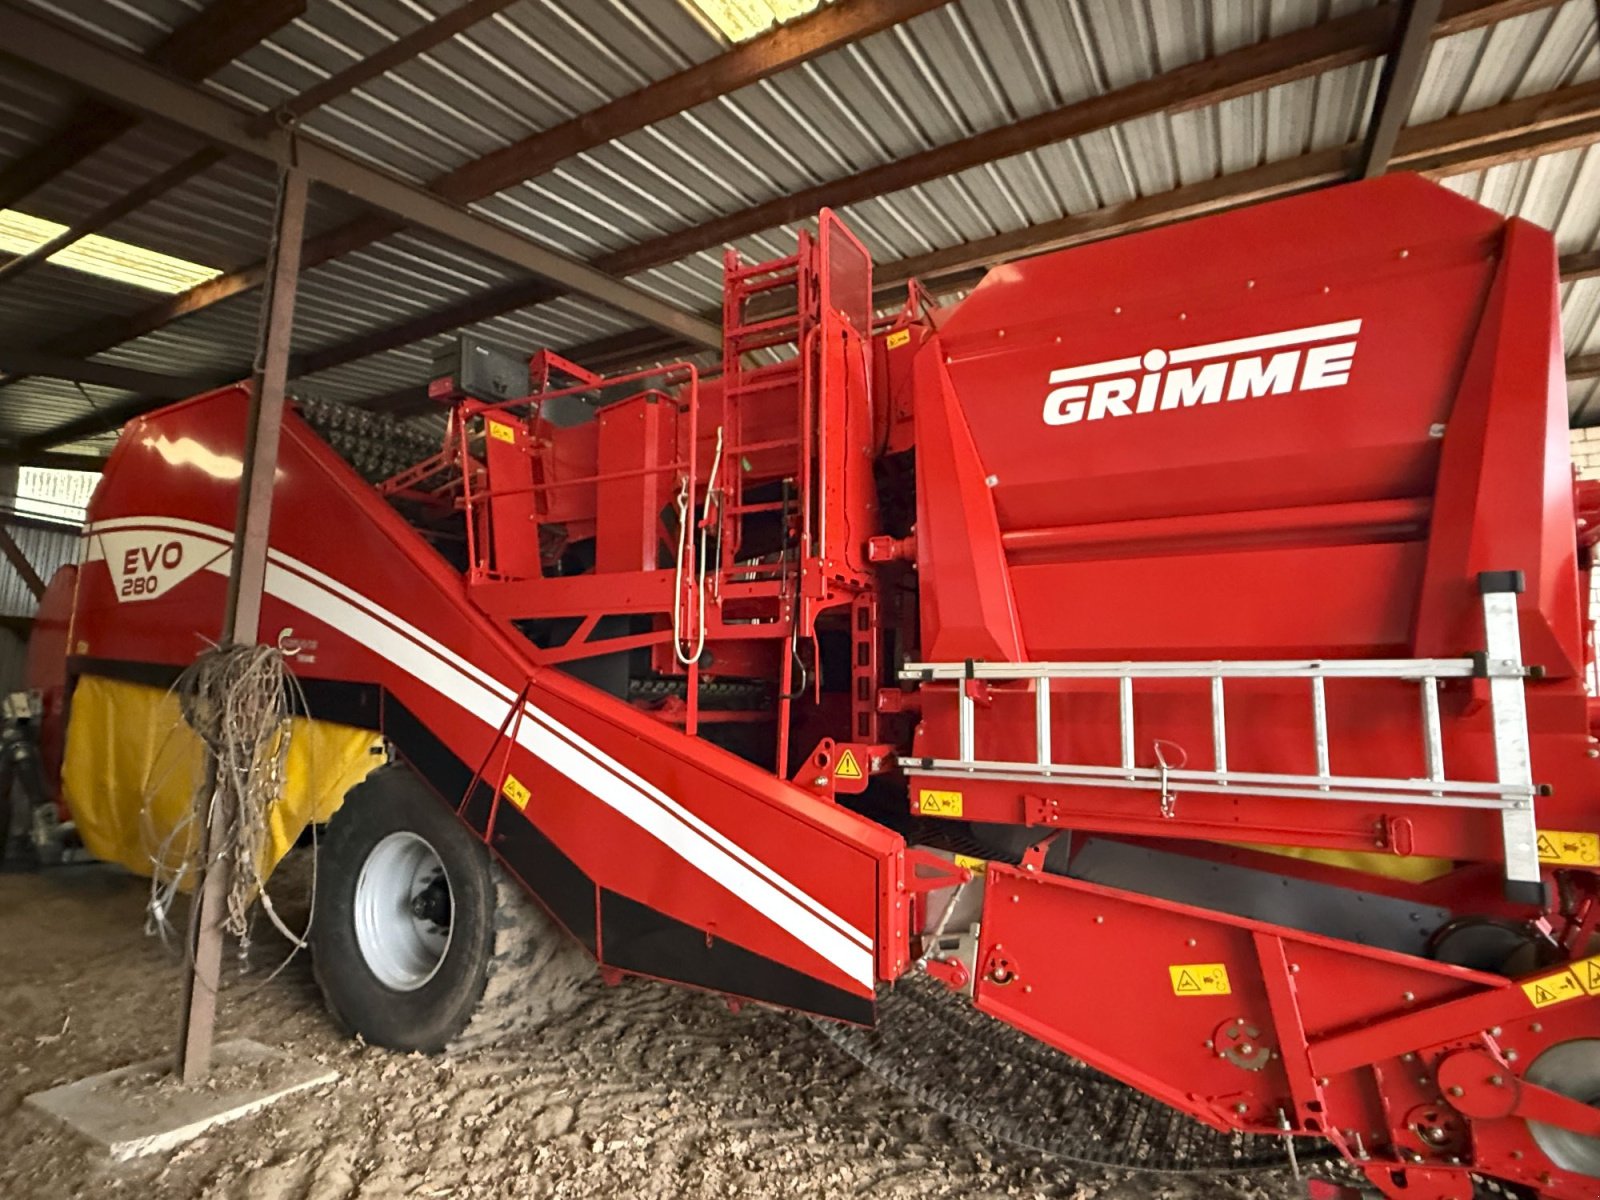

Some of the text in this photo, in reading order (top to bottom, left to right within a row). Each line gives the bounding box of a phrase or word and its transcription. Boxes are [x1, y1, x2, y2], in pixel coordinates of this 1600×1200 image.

[1042, 341, 1358, 426] GRIMME
[123, 541, 183, 575] EVO
[121, 575, 158, 597] 280
